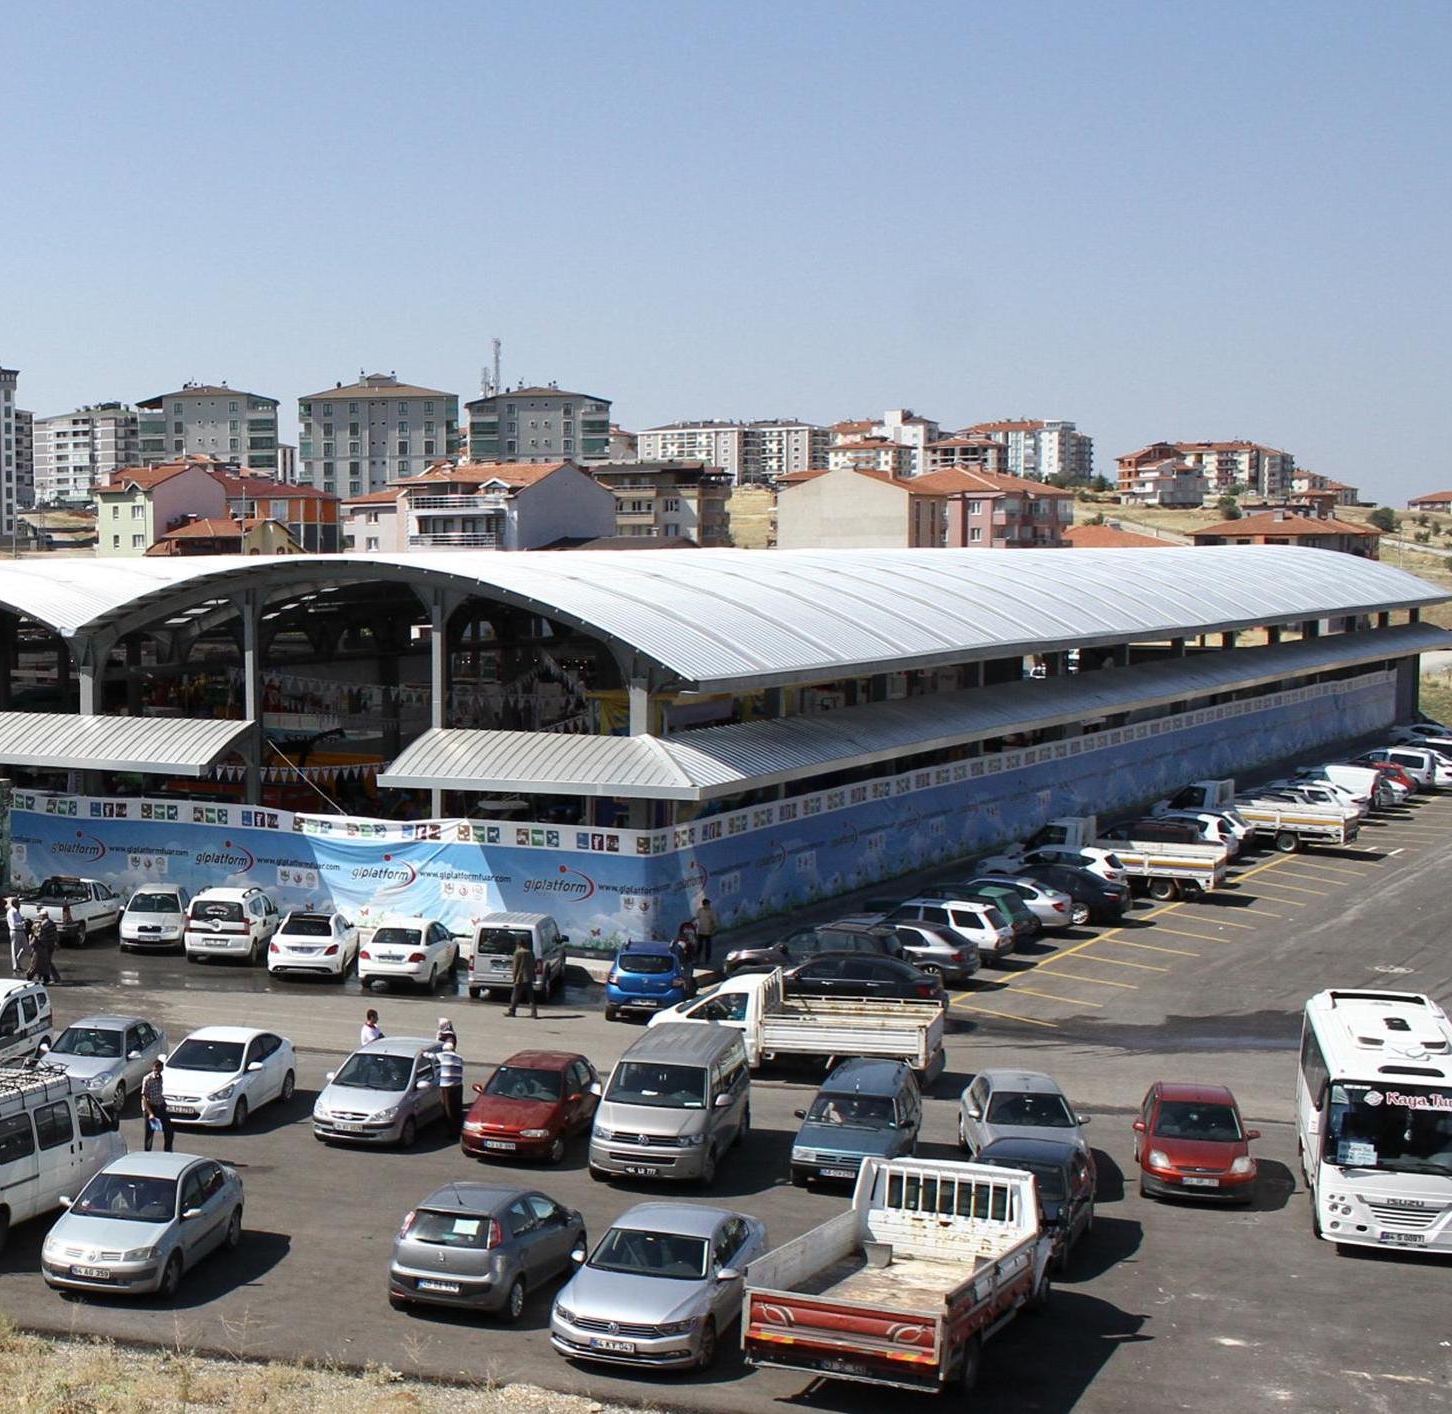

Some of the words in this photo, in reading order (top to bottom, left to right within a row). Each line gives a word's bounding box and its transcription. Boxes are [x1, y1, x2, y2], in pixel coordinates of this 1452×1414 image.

[351, 865, 410, 882] giplatform
[523, 878, 587, 894] giplatform
[1386, 1092, 1428, 1109] Kaya
[1387, 1198, 1425, 1208] ISUZU
